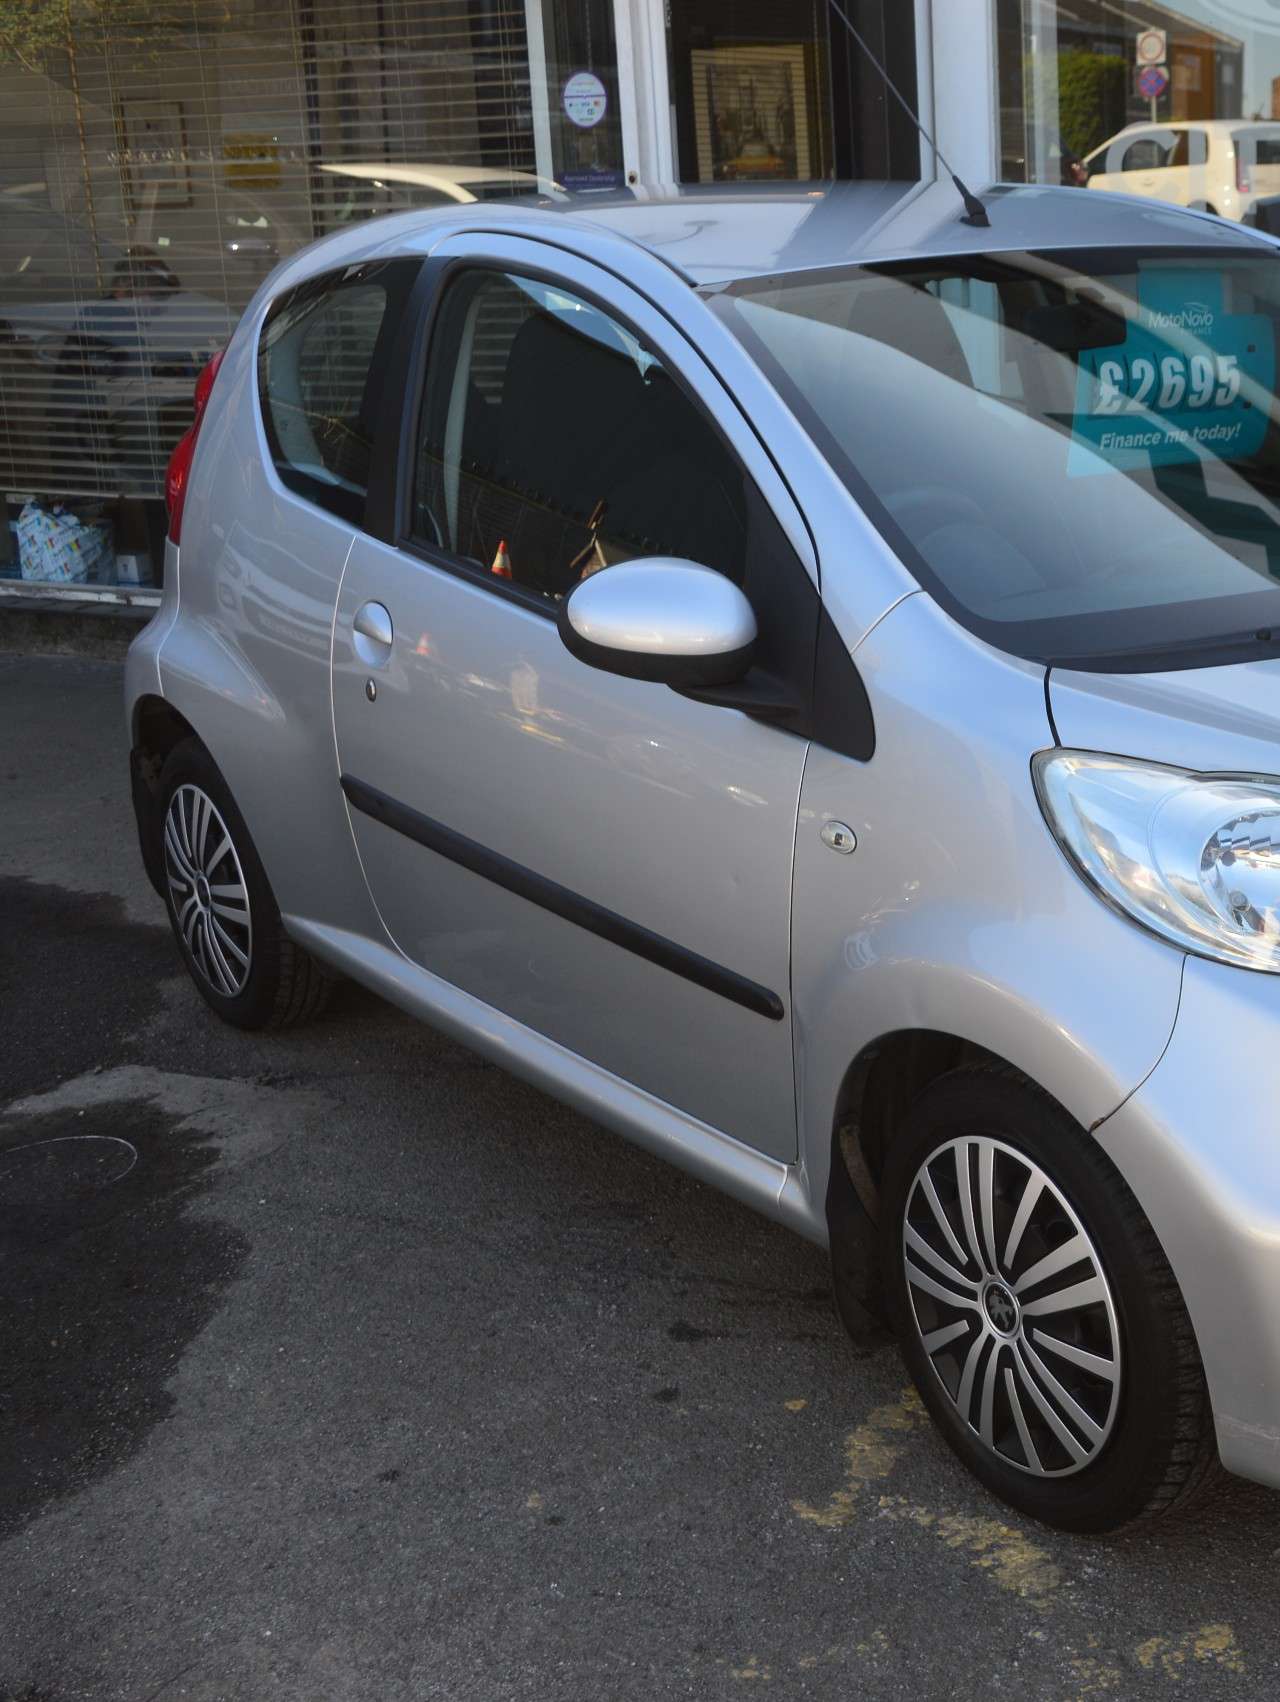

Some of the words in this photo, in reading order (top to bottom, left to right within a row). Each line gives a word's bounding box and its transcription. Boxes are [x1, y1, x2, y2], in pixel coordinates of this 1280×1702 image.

[1148, 310, 1214, 329] MotoNovo
[1093, 354, 1241, 415] £2695
[1100, 429, 1161, 450] Finance
[1164, 430, 1189, 444] me
[1192, 422, 1242, 444] today!
